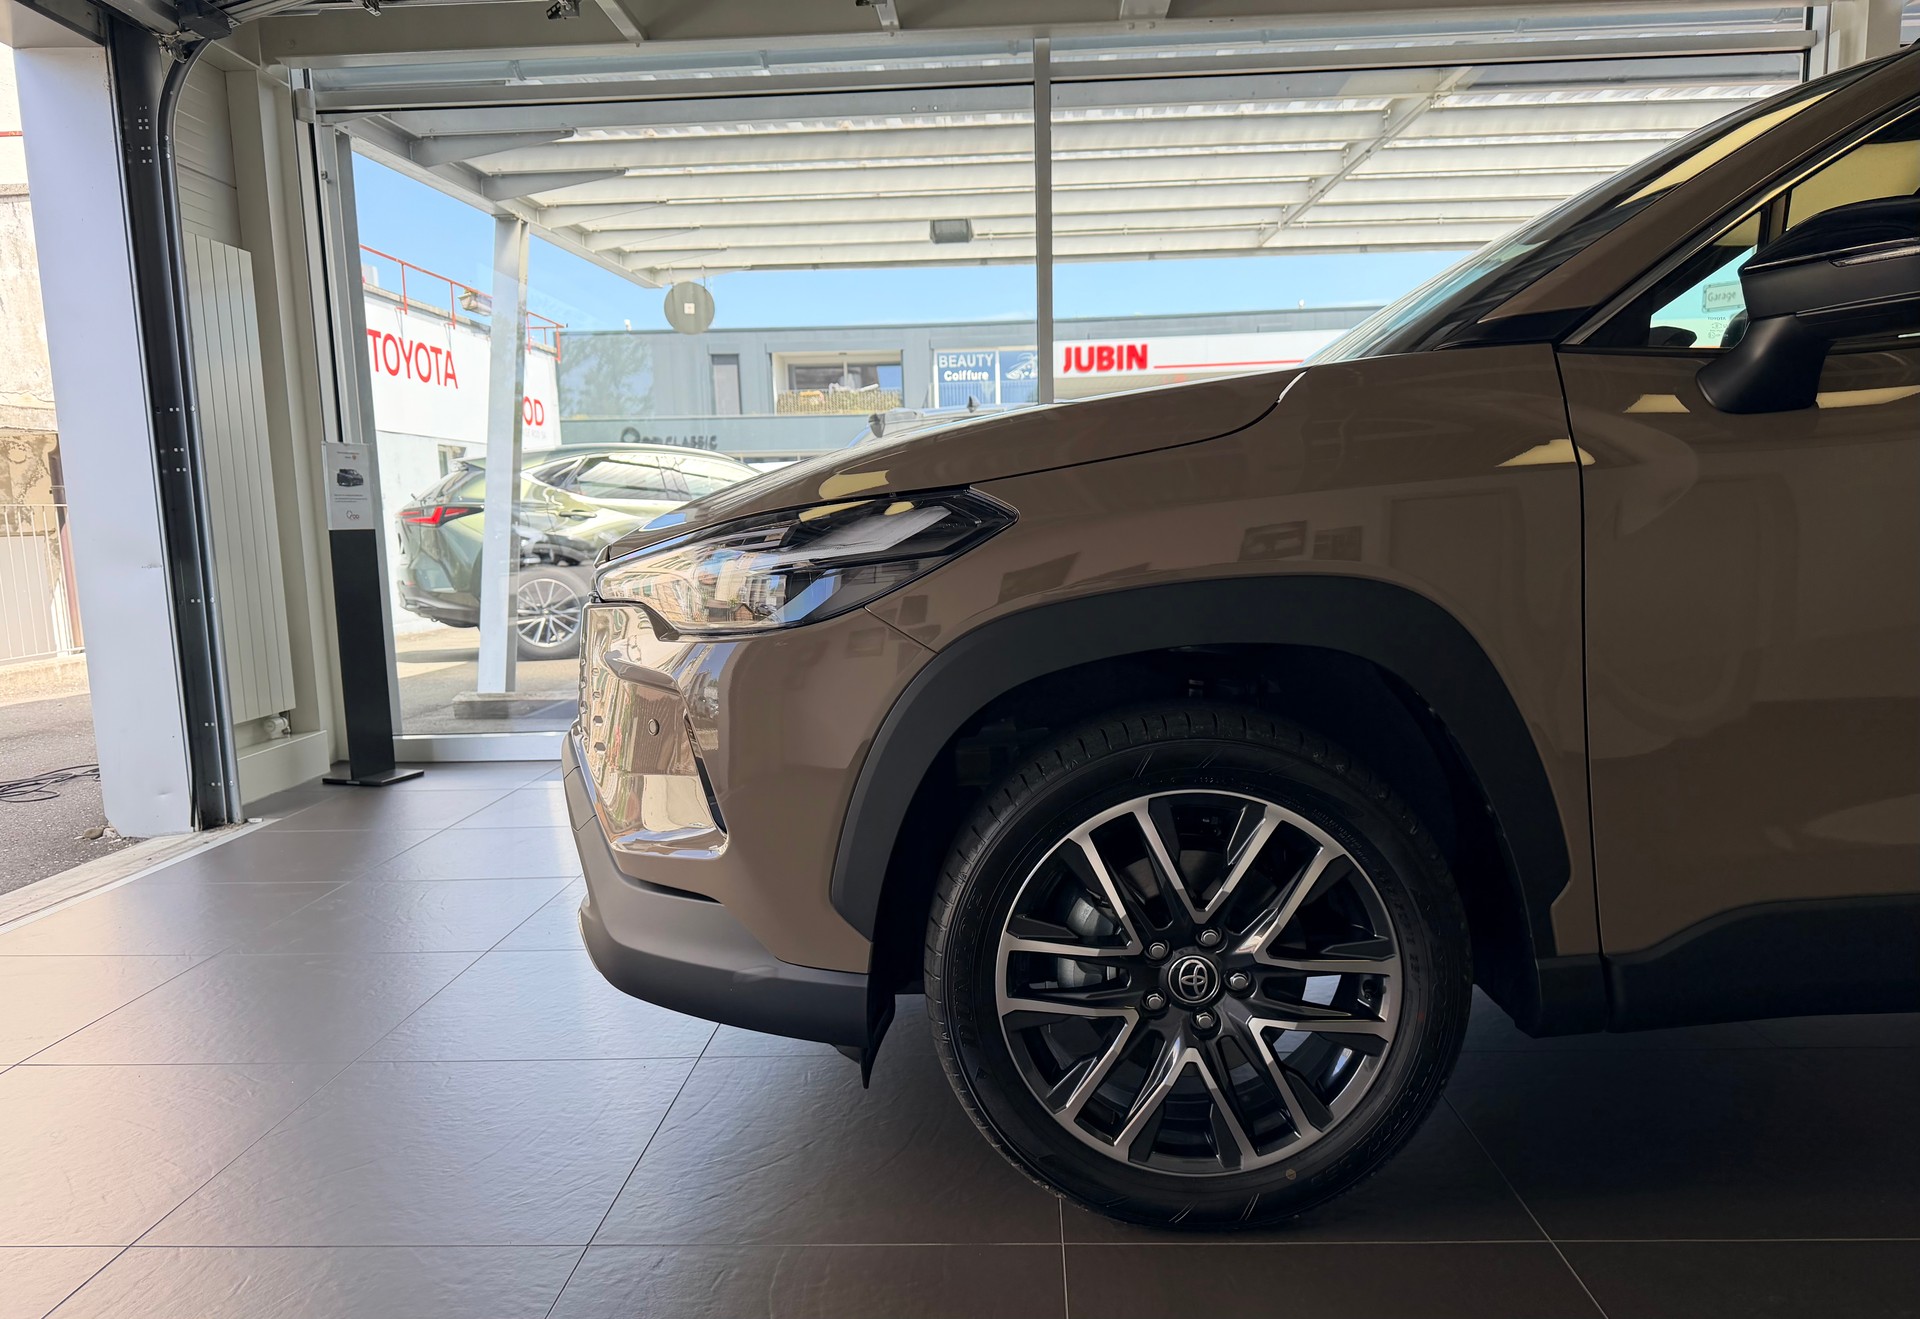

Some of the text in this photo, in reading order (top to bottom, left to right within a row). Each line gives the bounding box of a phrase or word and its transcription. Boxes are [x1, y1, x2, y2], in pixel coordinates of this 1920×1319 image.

[367, 328, 459, 390] TOYOTA
[938, 353, 994, 369] BEAUTY
[1063, 344, 1149, 374] JUBIN
[943, 370, 990, 382] Coiffure
[523, 395, 545, 427] OD
